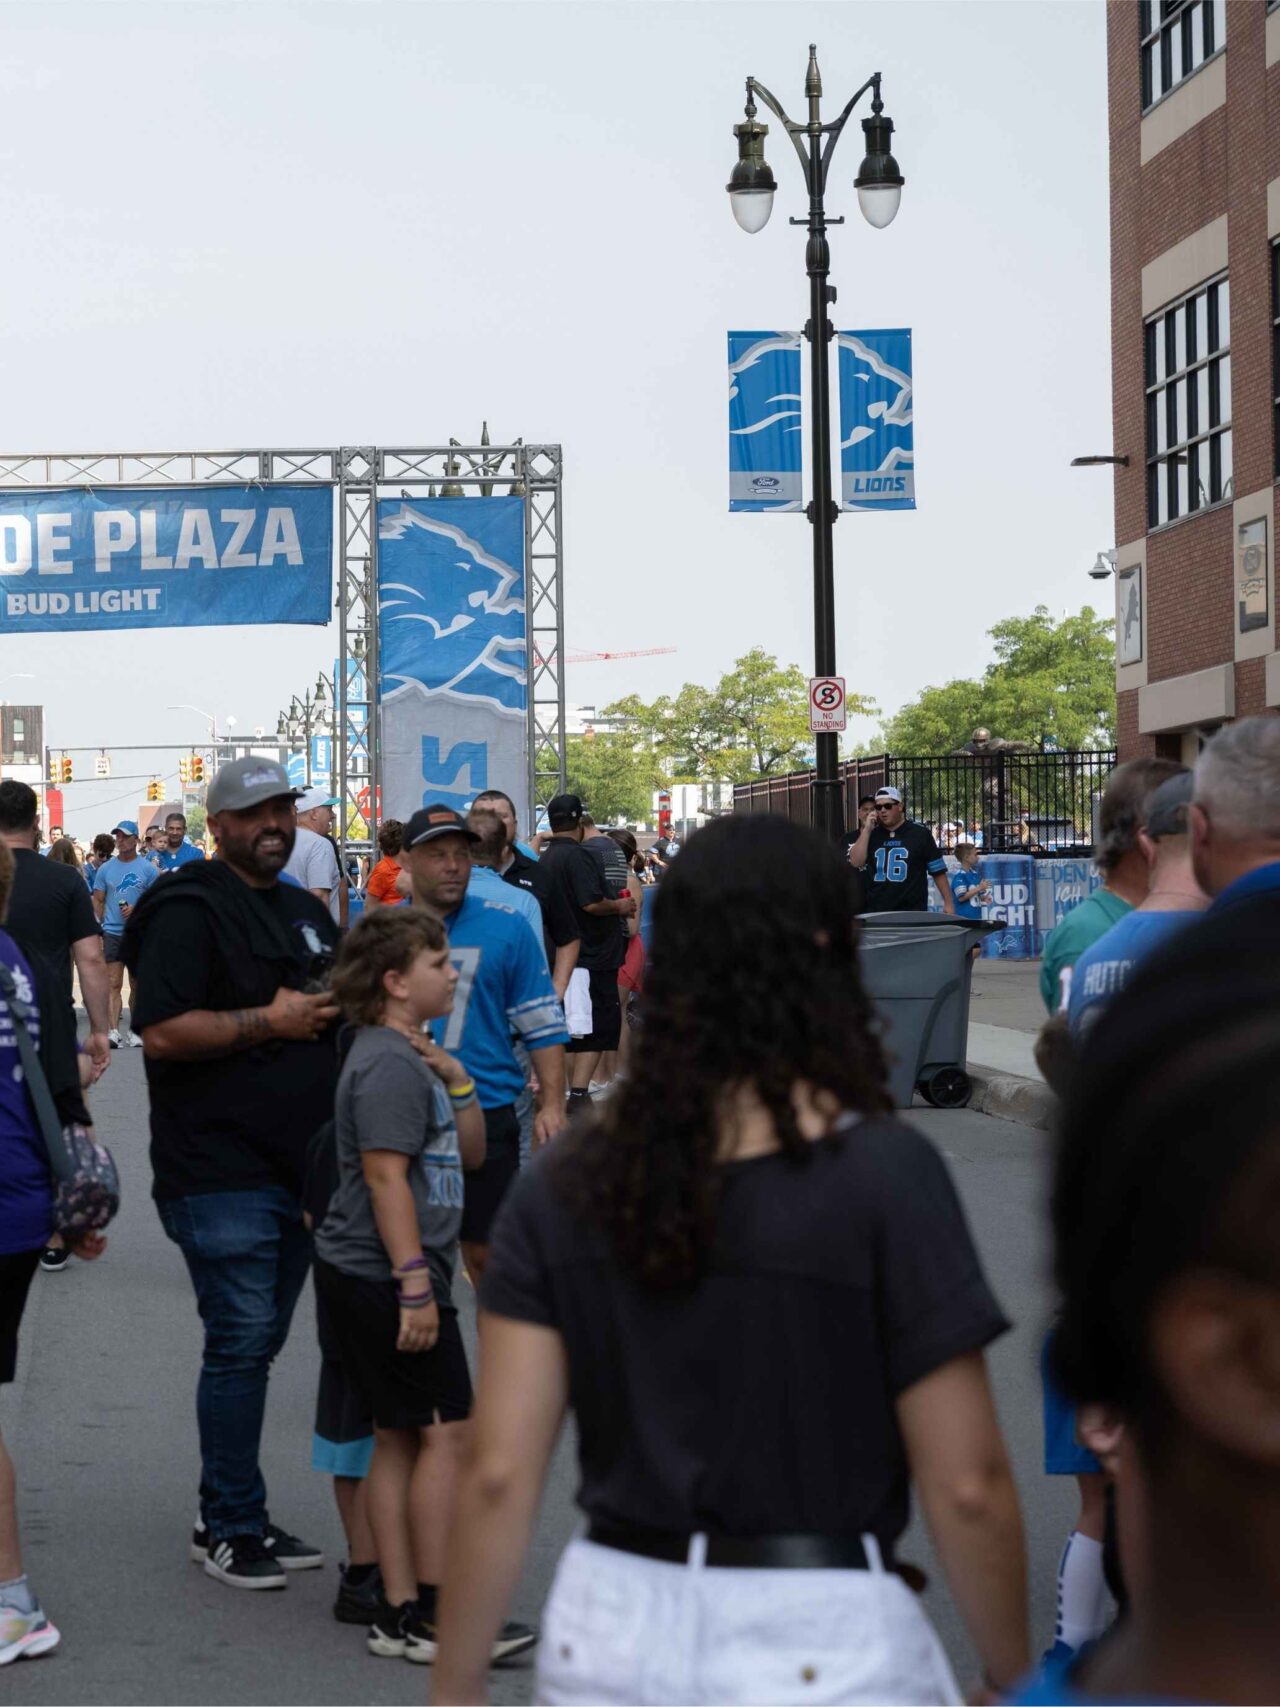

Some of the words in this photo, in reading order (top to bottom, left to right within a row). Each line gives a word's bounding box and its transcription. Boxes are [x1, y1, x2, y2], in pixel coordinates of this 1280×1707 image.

[854, 477, 906, 493] LIONS
[94, 507, 304, 572] PLAZA
[7, 591, 71, 616] BUD
[75, 588, 162, 614] LIGHT
[812, 720, 844, 729] STANDING
[822, 712, 834, 720] NO
[874, 847, 909, 882] 16
[981, 884, 1029, 905] UD
[981, 905, 1035, 926] IGHT
